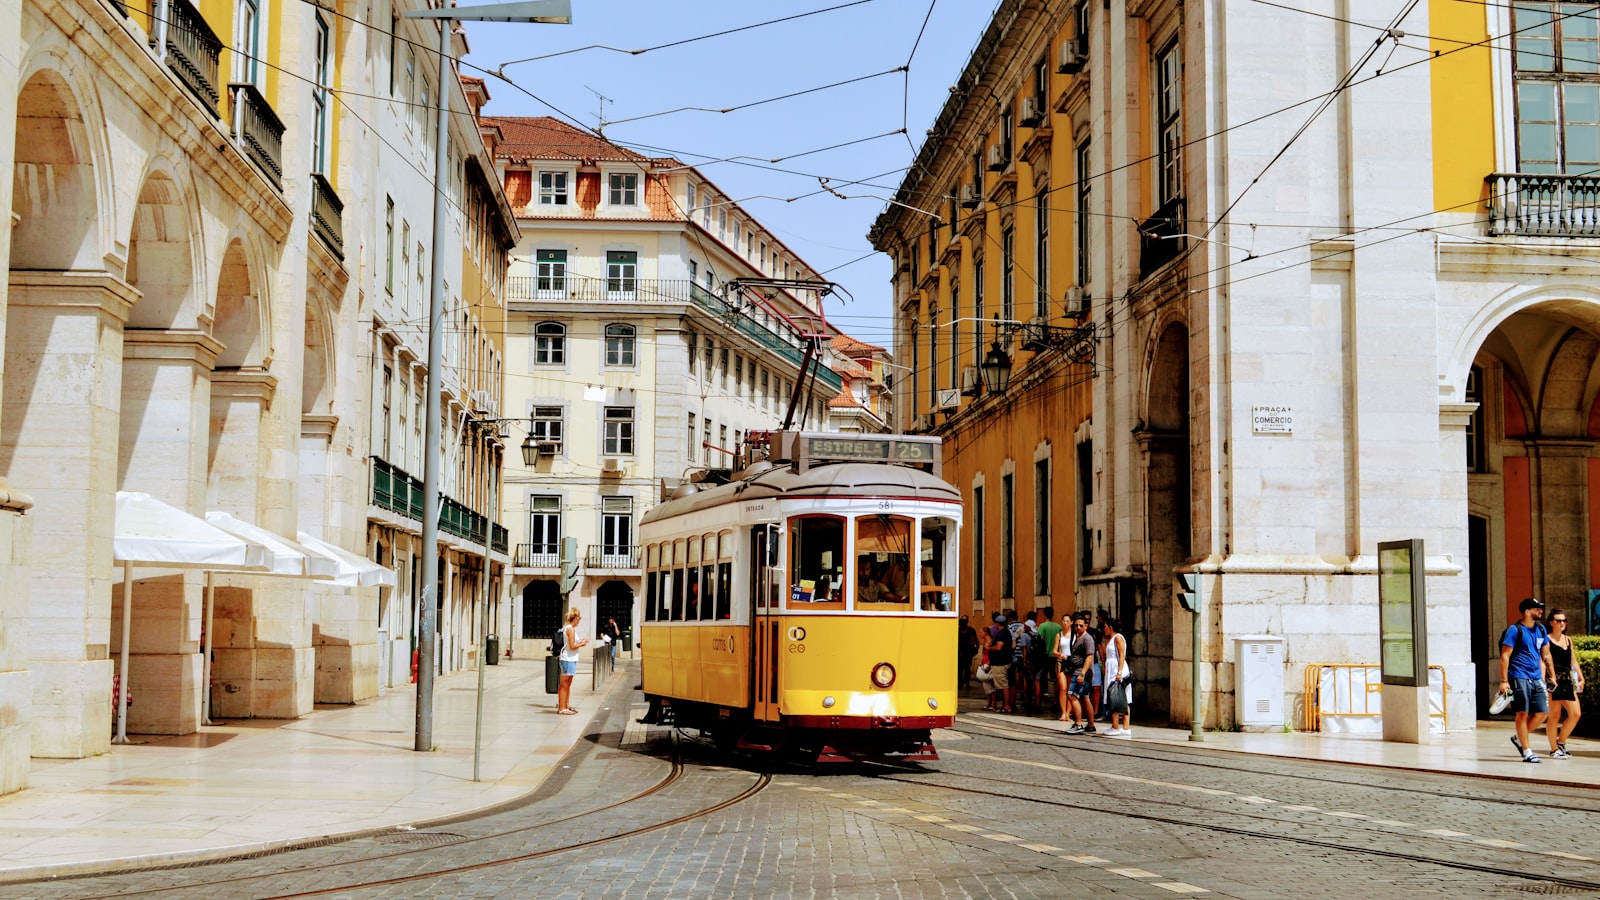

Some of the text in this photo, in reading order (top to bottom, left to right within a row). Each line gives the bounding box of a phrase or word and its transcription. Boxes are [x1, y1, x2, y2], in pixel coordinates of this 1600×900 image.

[814, 440, 883, 453] ESTRELA
[898, 443, 922, 458] 25
[878, 501, 894, 510] 581
